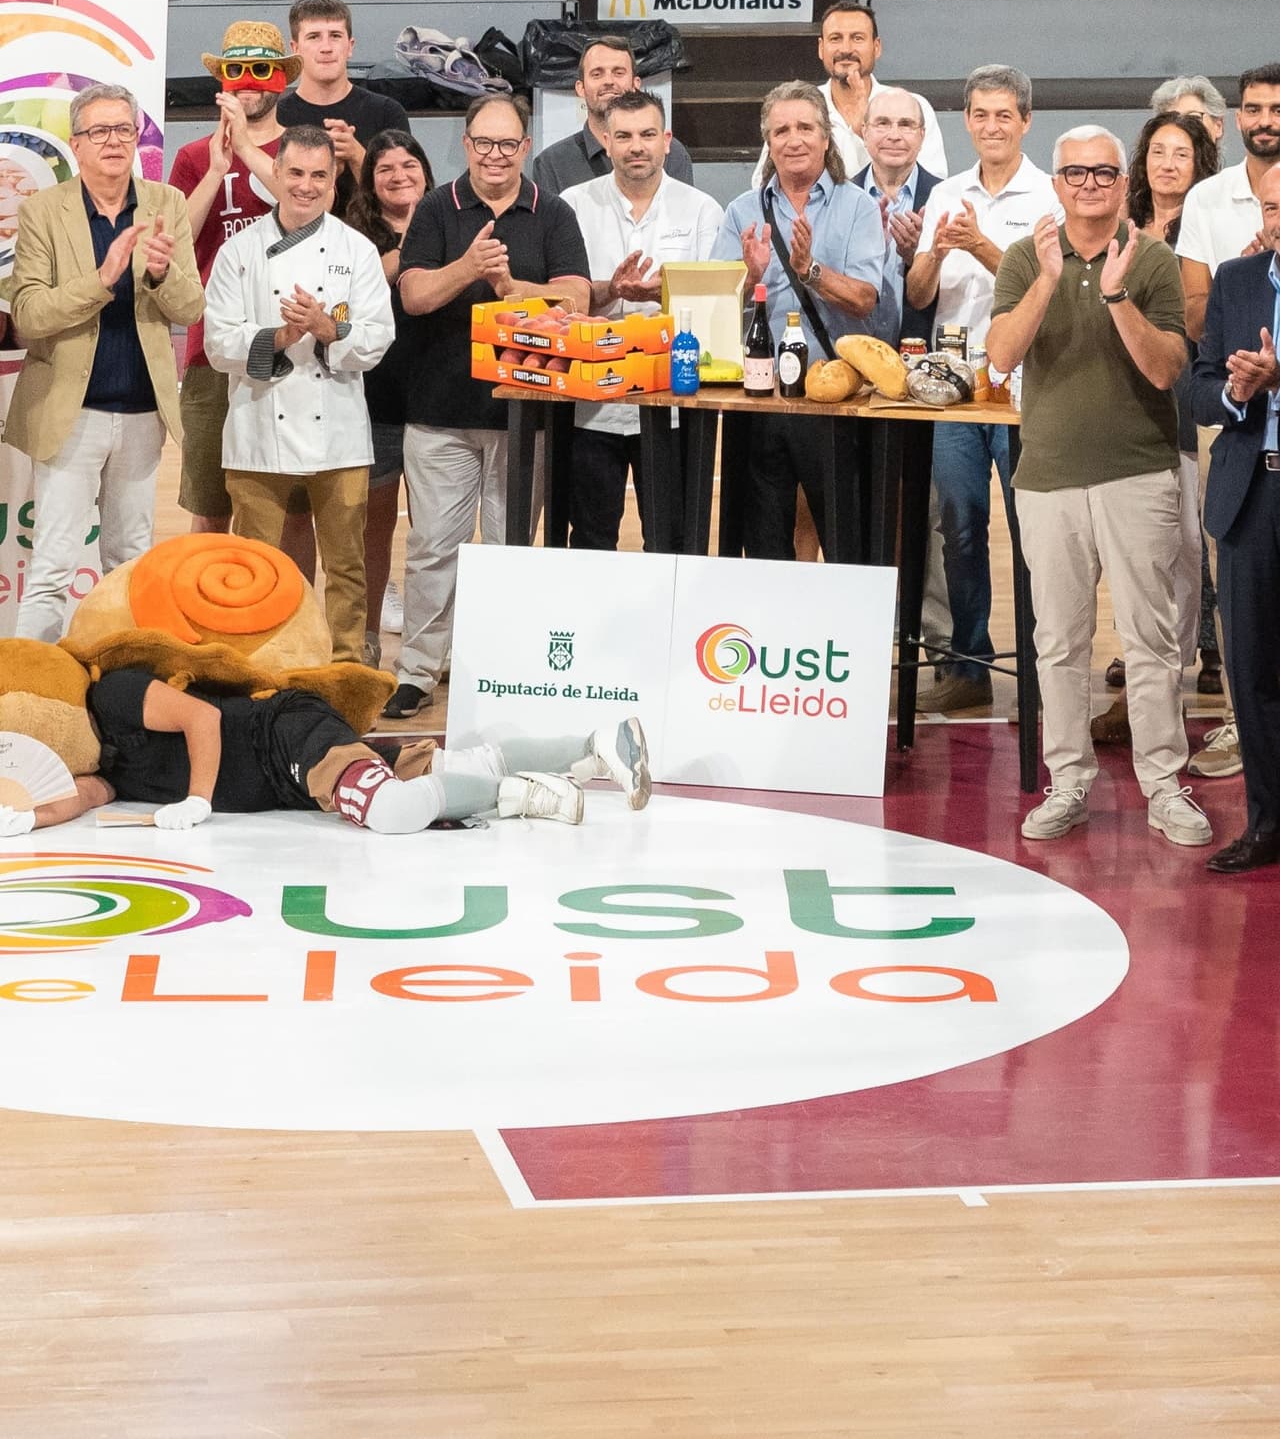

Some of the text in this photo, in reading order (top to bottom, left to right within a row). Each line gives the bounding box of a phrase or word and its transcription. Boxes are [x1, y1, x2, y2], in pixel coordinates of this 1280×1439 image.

[477, 678, 639, 703] Diputació de Lleida
